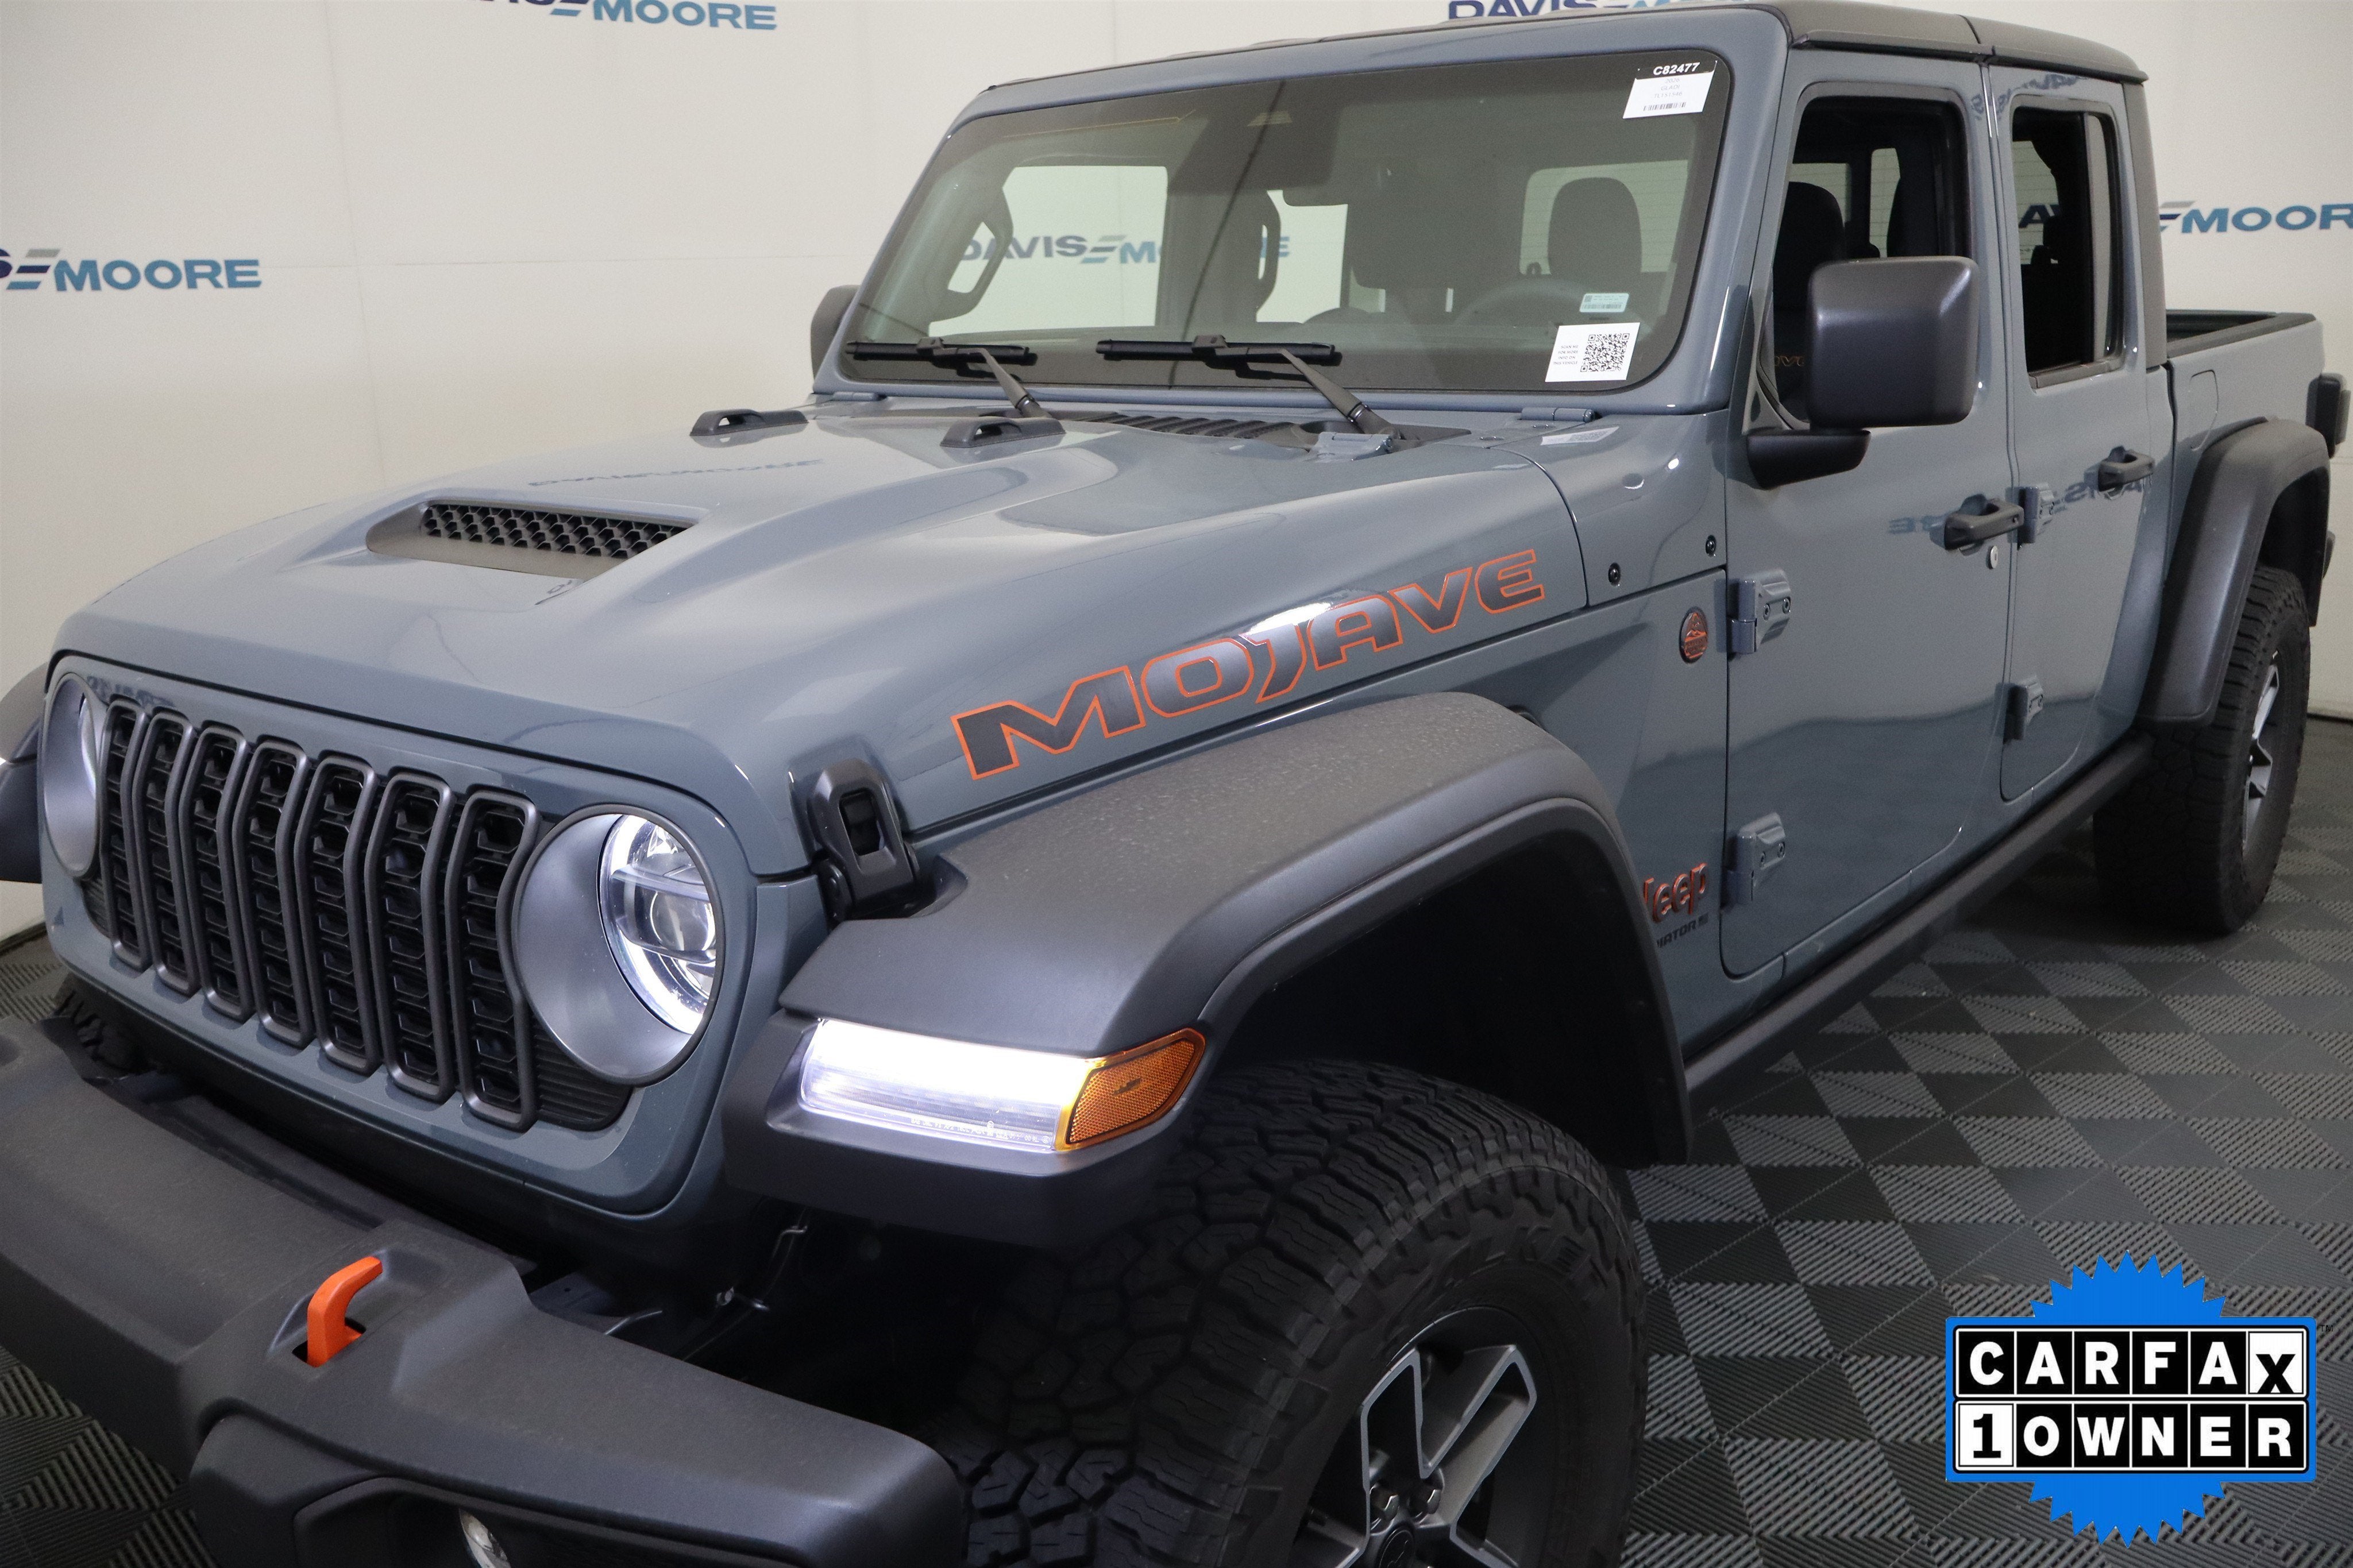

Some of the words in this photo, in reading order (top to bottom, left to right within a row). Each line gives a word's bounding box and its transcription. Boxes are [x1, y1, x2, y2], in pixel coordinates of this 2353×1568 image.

[593, 0, 777, 30] MOORE
[1653, 61, 1700, 75] C82477
[53, 259, 262, 292] MOORE
[951, 549, 1545, 781] MOJAVE
